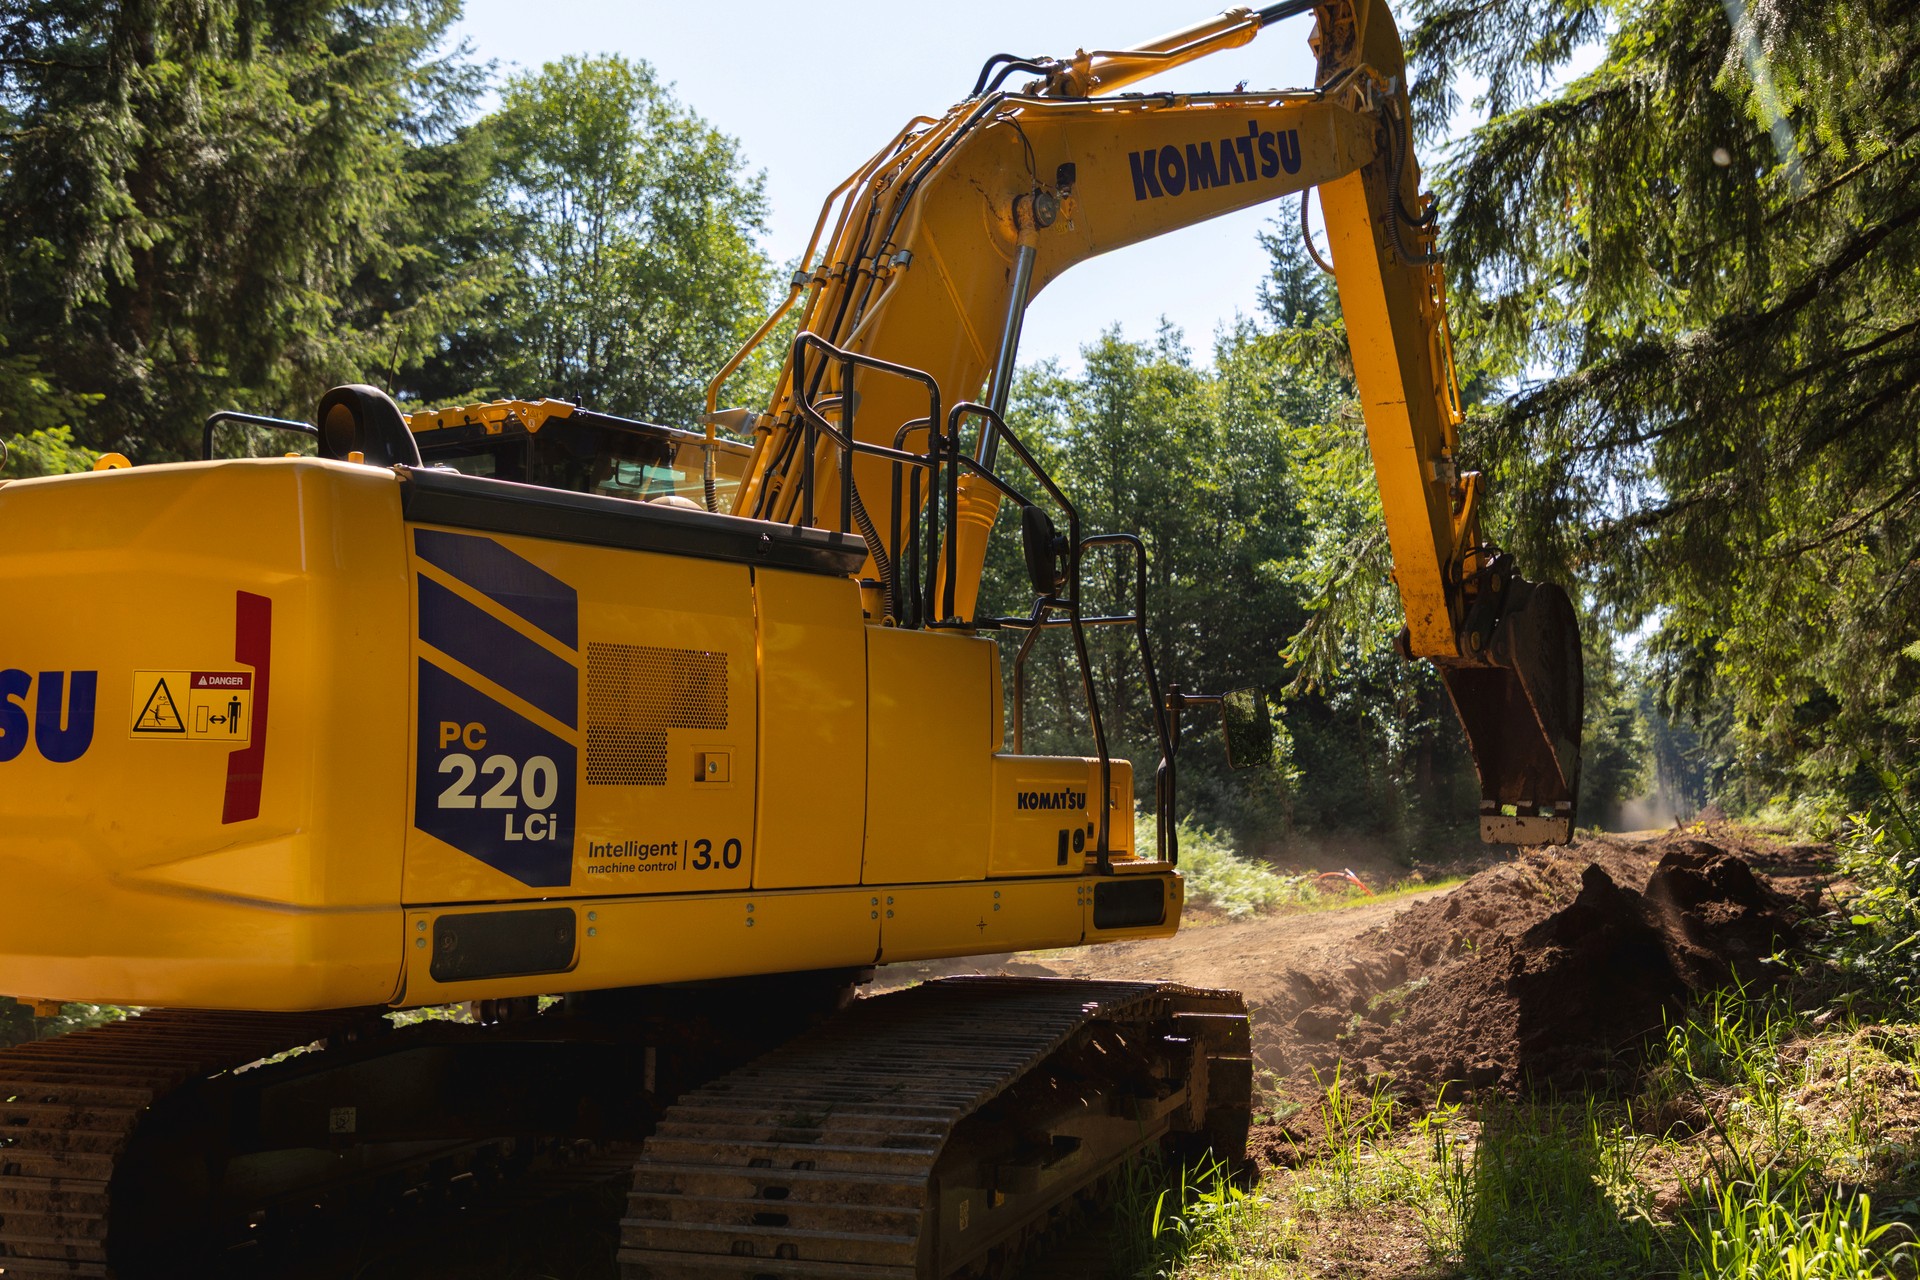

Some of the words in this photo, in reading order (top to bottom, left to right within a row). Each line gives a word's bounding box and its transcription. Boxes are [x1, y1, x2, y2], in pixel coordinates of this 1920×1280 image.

[1128, 120, 1301, 200] KOMATSU
[208, 676, 243, 686] DANGER
[439, 721, 487, 750] PC
[437, 753, 558, 810] 220
[1017, 787, 1086, 810] KOMATSU
[504, 813, 557, 841] LCi
[588, 840, 678, 860] Intelligent
[692, 838, 742, 870] 3.0
[587, 863, 636, 874] machine
[637, 861, 677, 872] control
